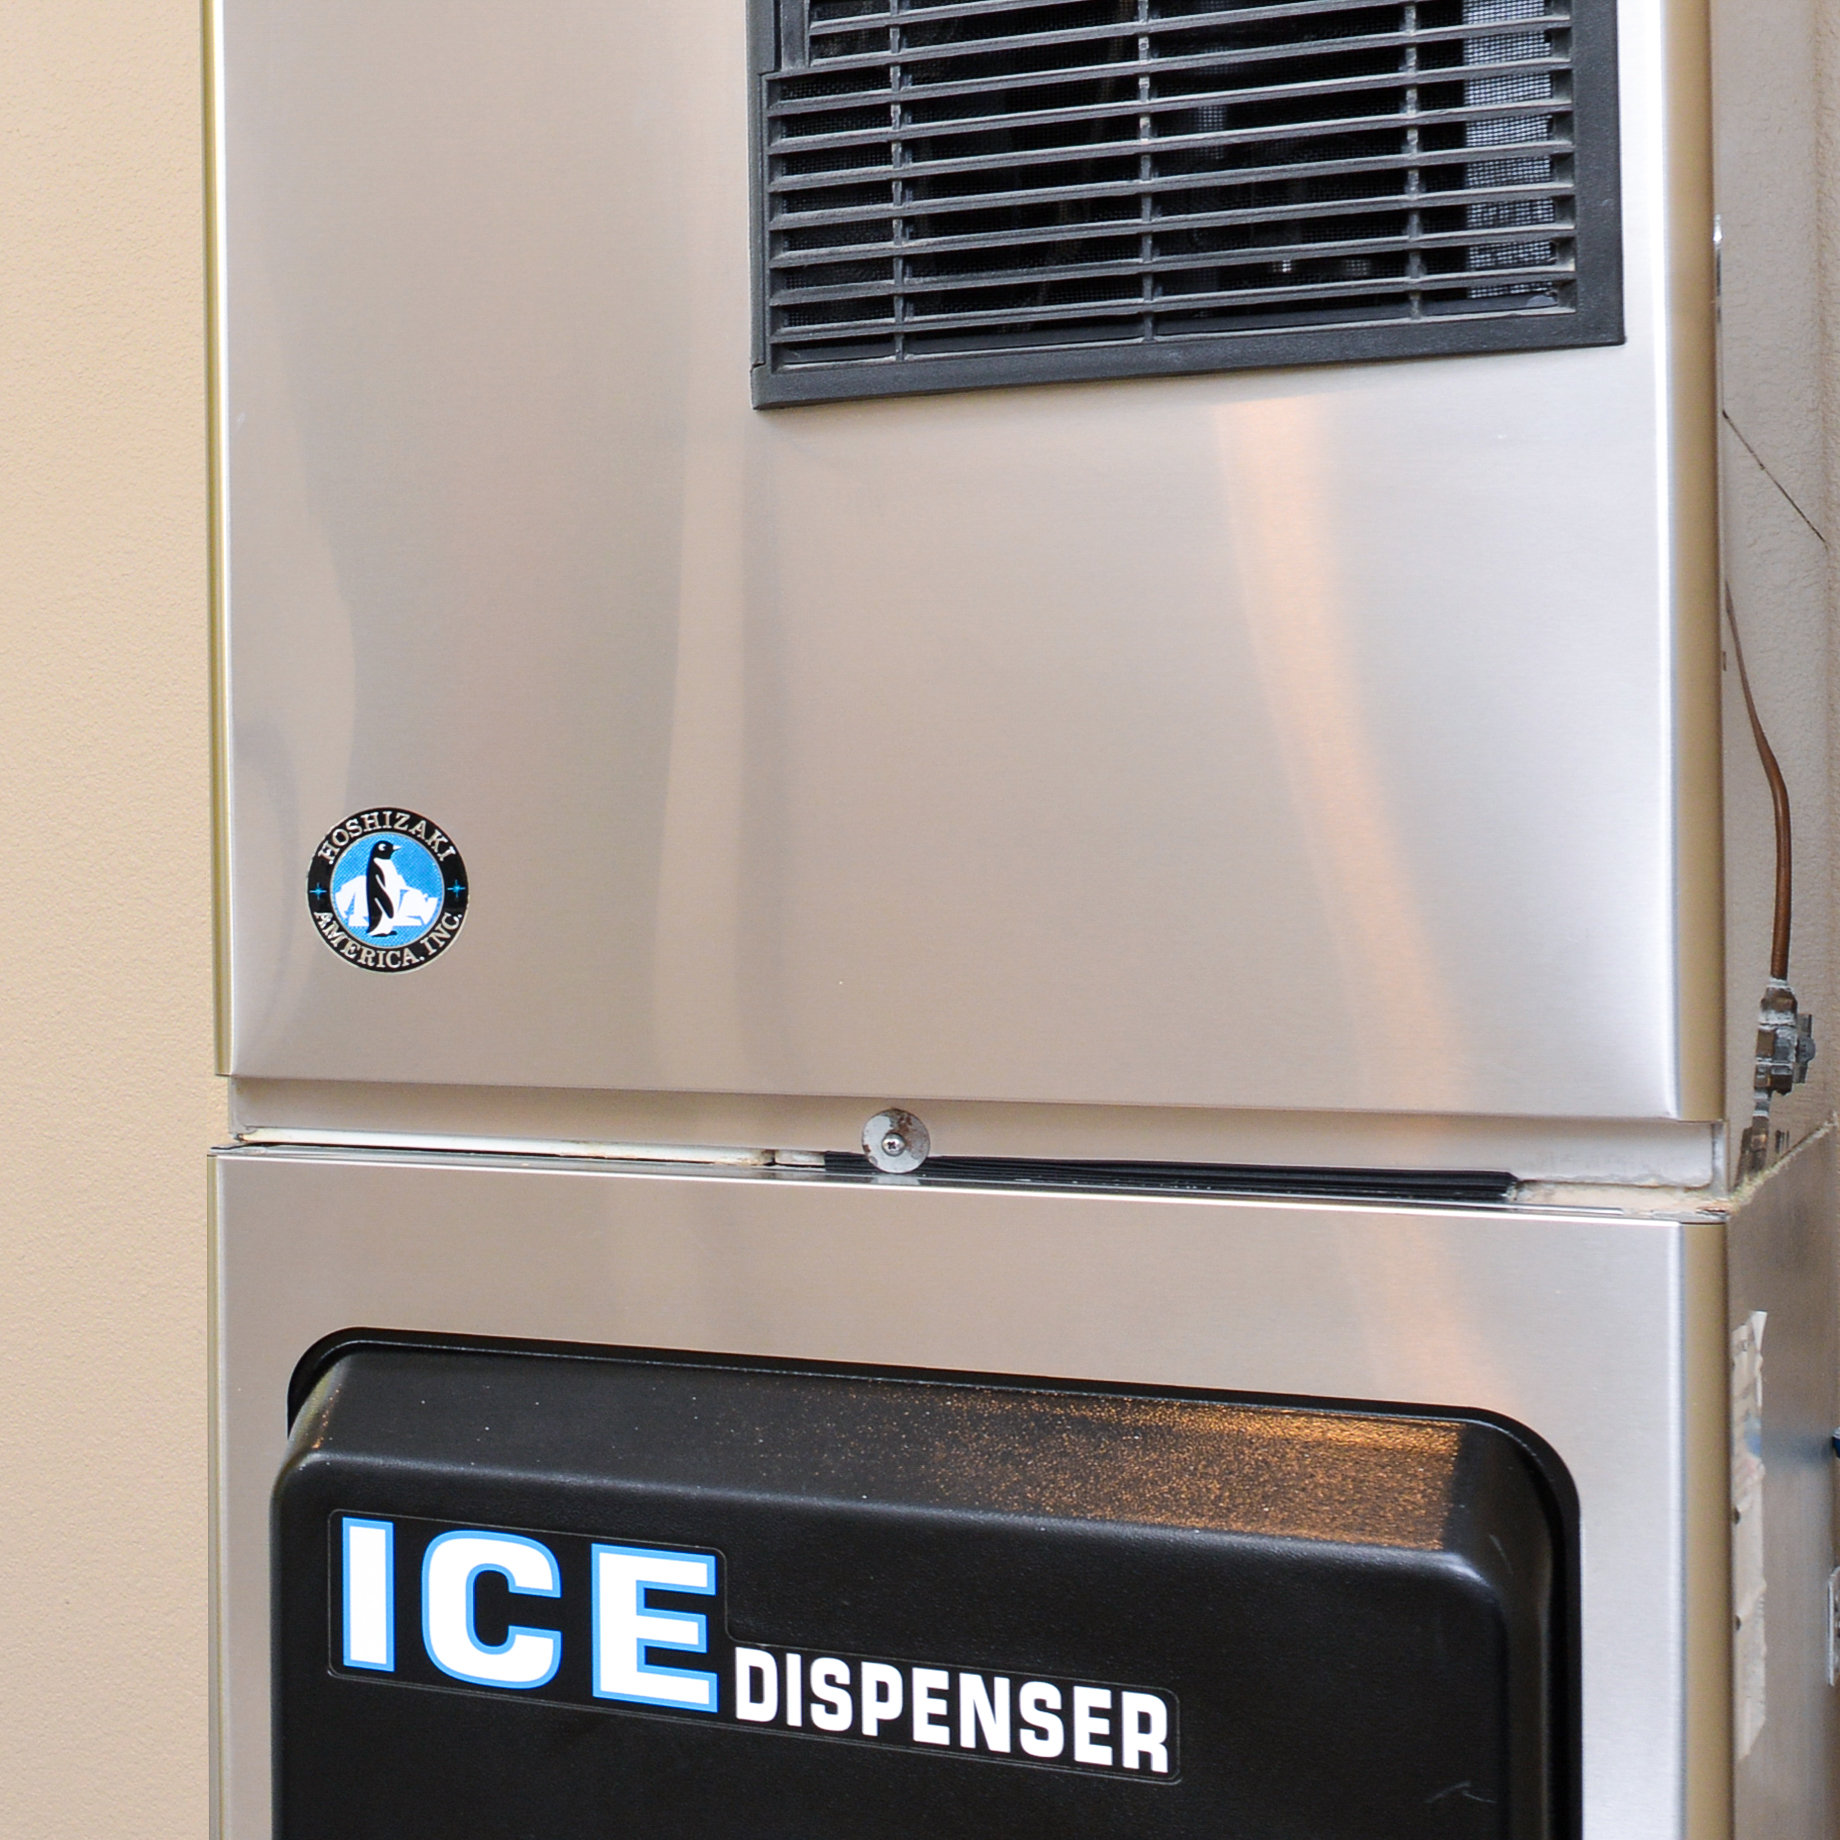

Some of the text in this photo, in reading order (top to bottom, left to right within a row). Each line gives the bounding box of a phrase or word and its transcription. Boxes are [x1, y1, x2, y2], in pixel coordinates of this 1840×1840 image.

[317, 811, 457, 865] HOSHIZAKI
[424, 913, 463, 957] INC.
[341, 1515, 1171, 1774] ICE DISPENSER
